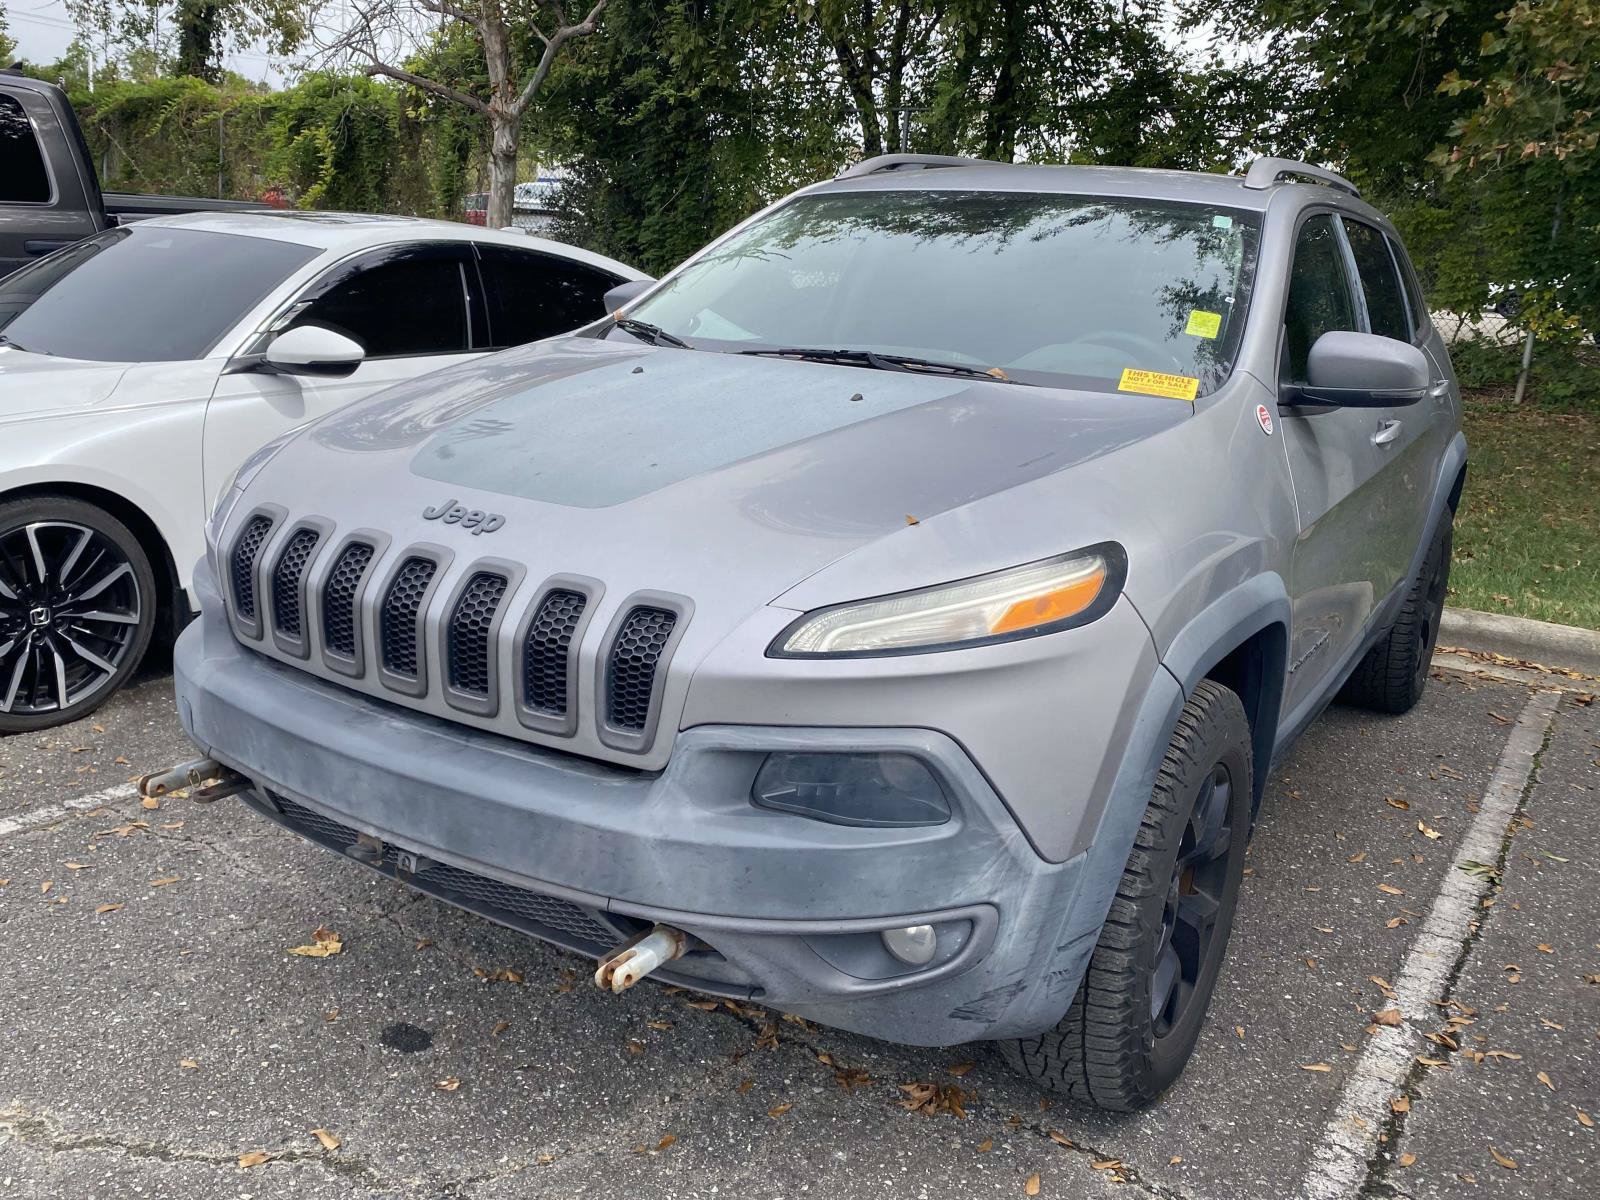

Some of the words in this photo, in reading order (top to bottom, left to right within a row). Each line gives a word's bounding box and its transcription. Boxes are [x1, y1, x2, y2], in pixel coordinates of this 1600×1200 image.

[1127, 370, 1149, 378] THIS
[1152, 373, 1193, 384] VEHICLE
[1167, 381, 1190, 389] SALE
[422, 499, 506, 536] Jeep
